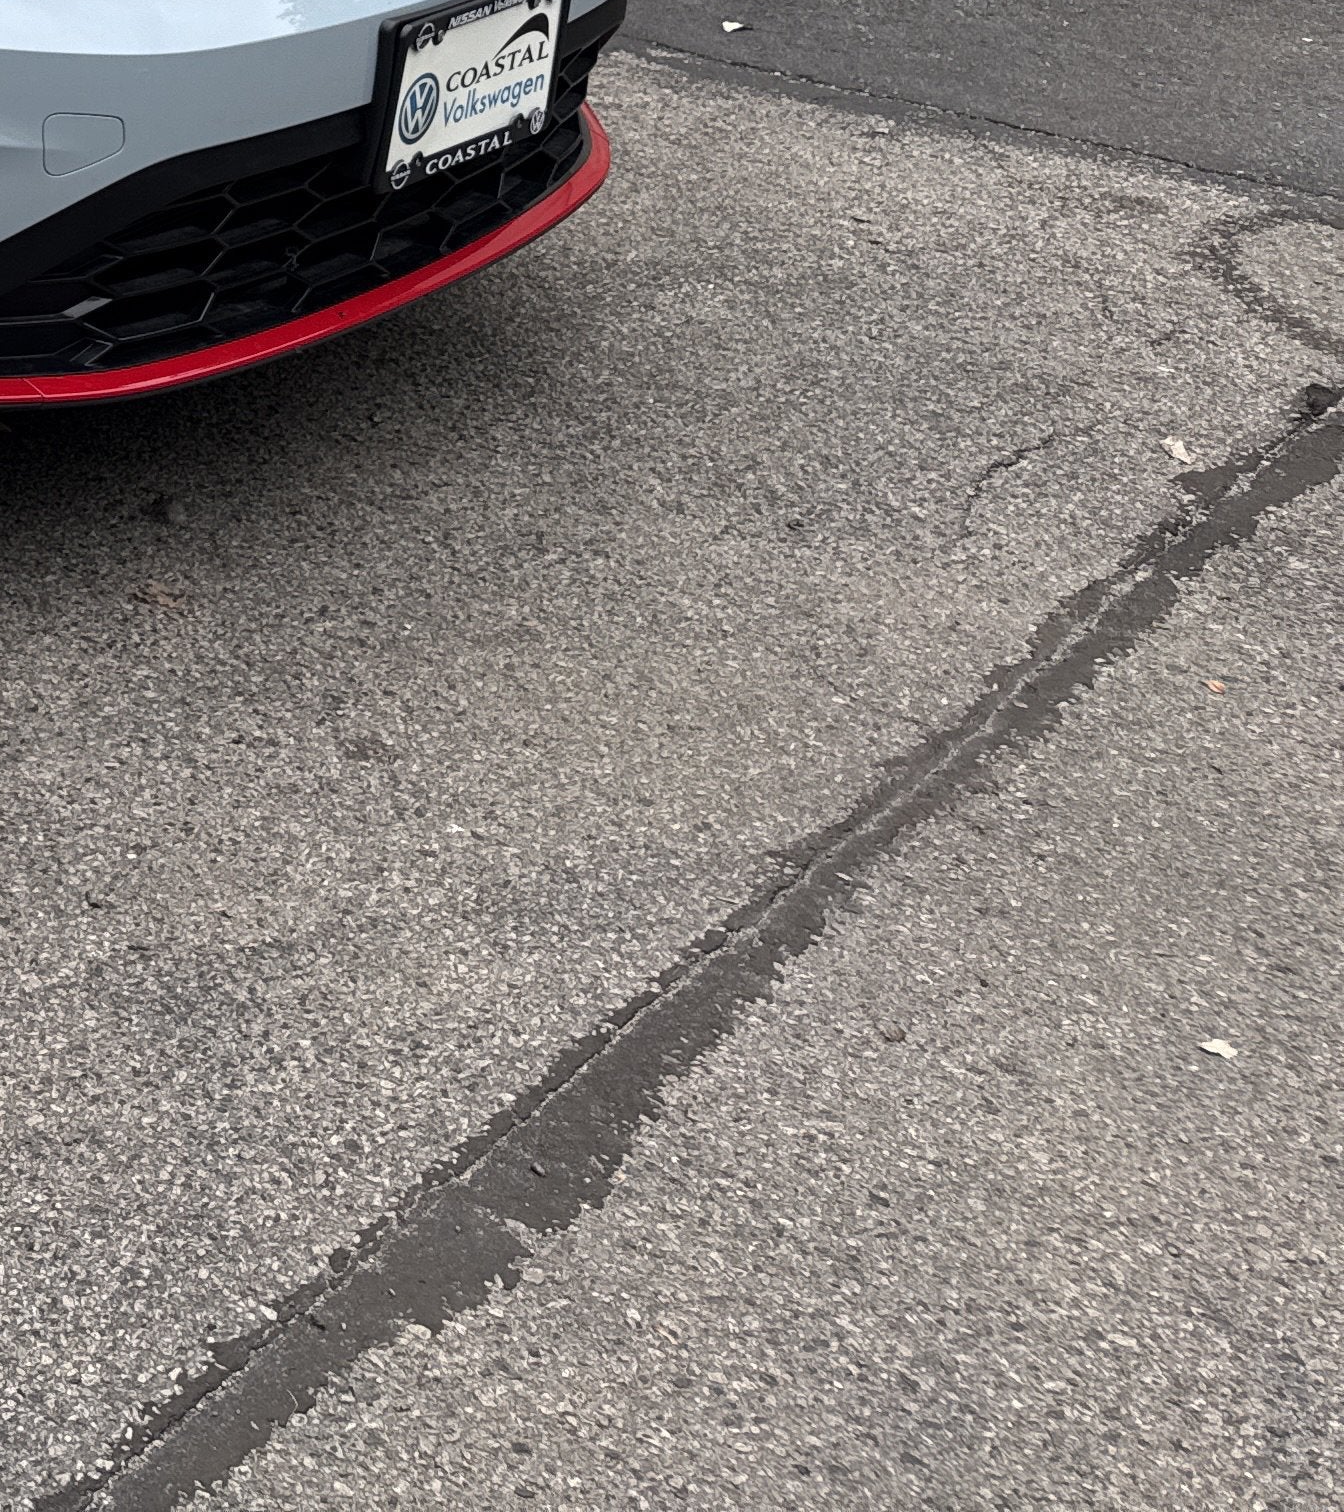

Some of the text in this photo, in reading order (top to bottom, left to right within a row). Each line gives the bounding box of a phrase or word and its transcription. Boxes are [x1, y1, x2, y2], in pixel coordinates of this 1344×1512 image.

[447, 4, 493, 30] NISSAN
[445, 40, 550, 92] COASTAL
[443, 73, 545, 128] Volkswagen
[425, 130, 512, 176] COASTAL
